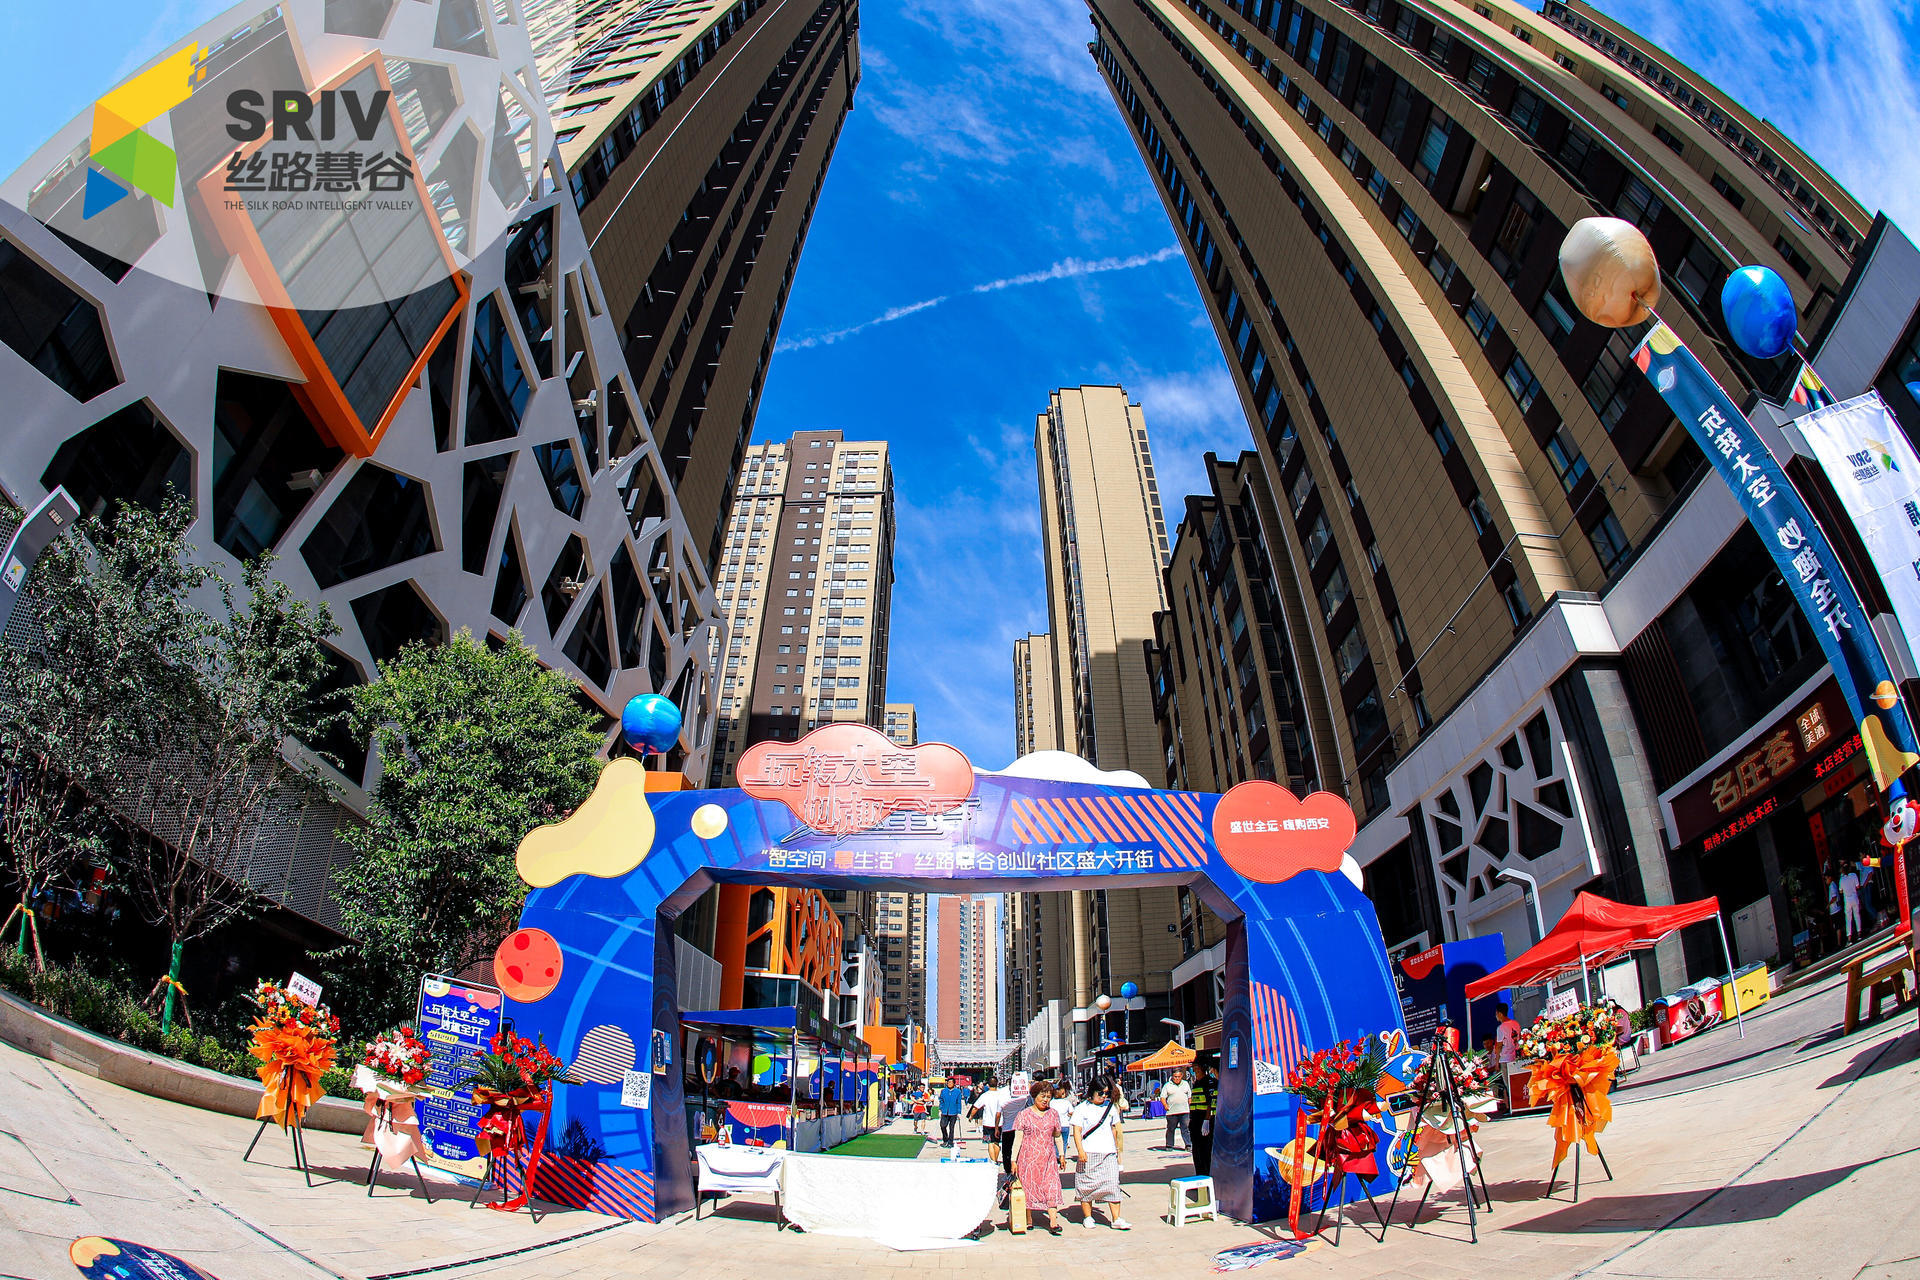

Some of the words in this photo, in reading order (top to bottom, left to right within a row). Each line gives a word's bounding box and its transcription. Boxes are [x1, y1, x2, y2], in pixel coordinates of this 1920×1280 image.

[1800, 708, 1821, 732] 全球
[1805, 723, 1826, 748] 美酒
[1710, 729, 1797, 813] 名庄荟
